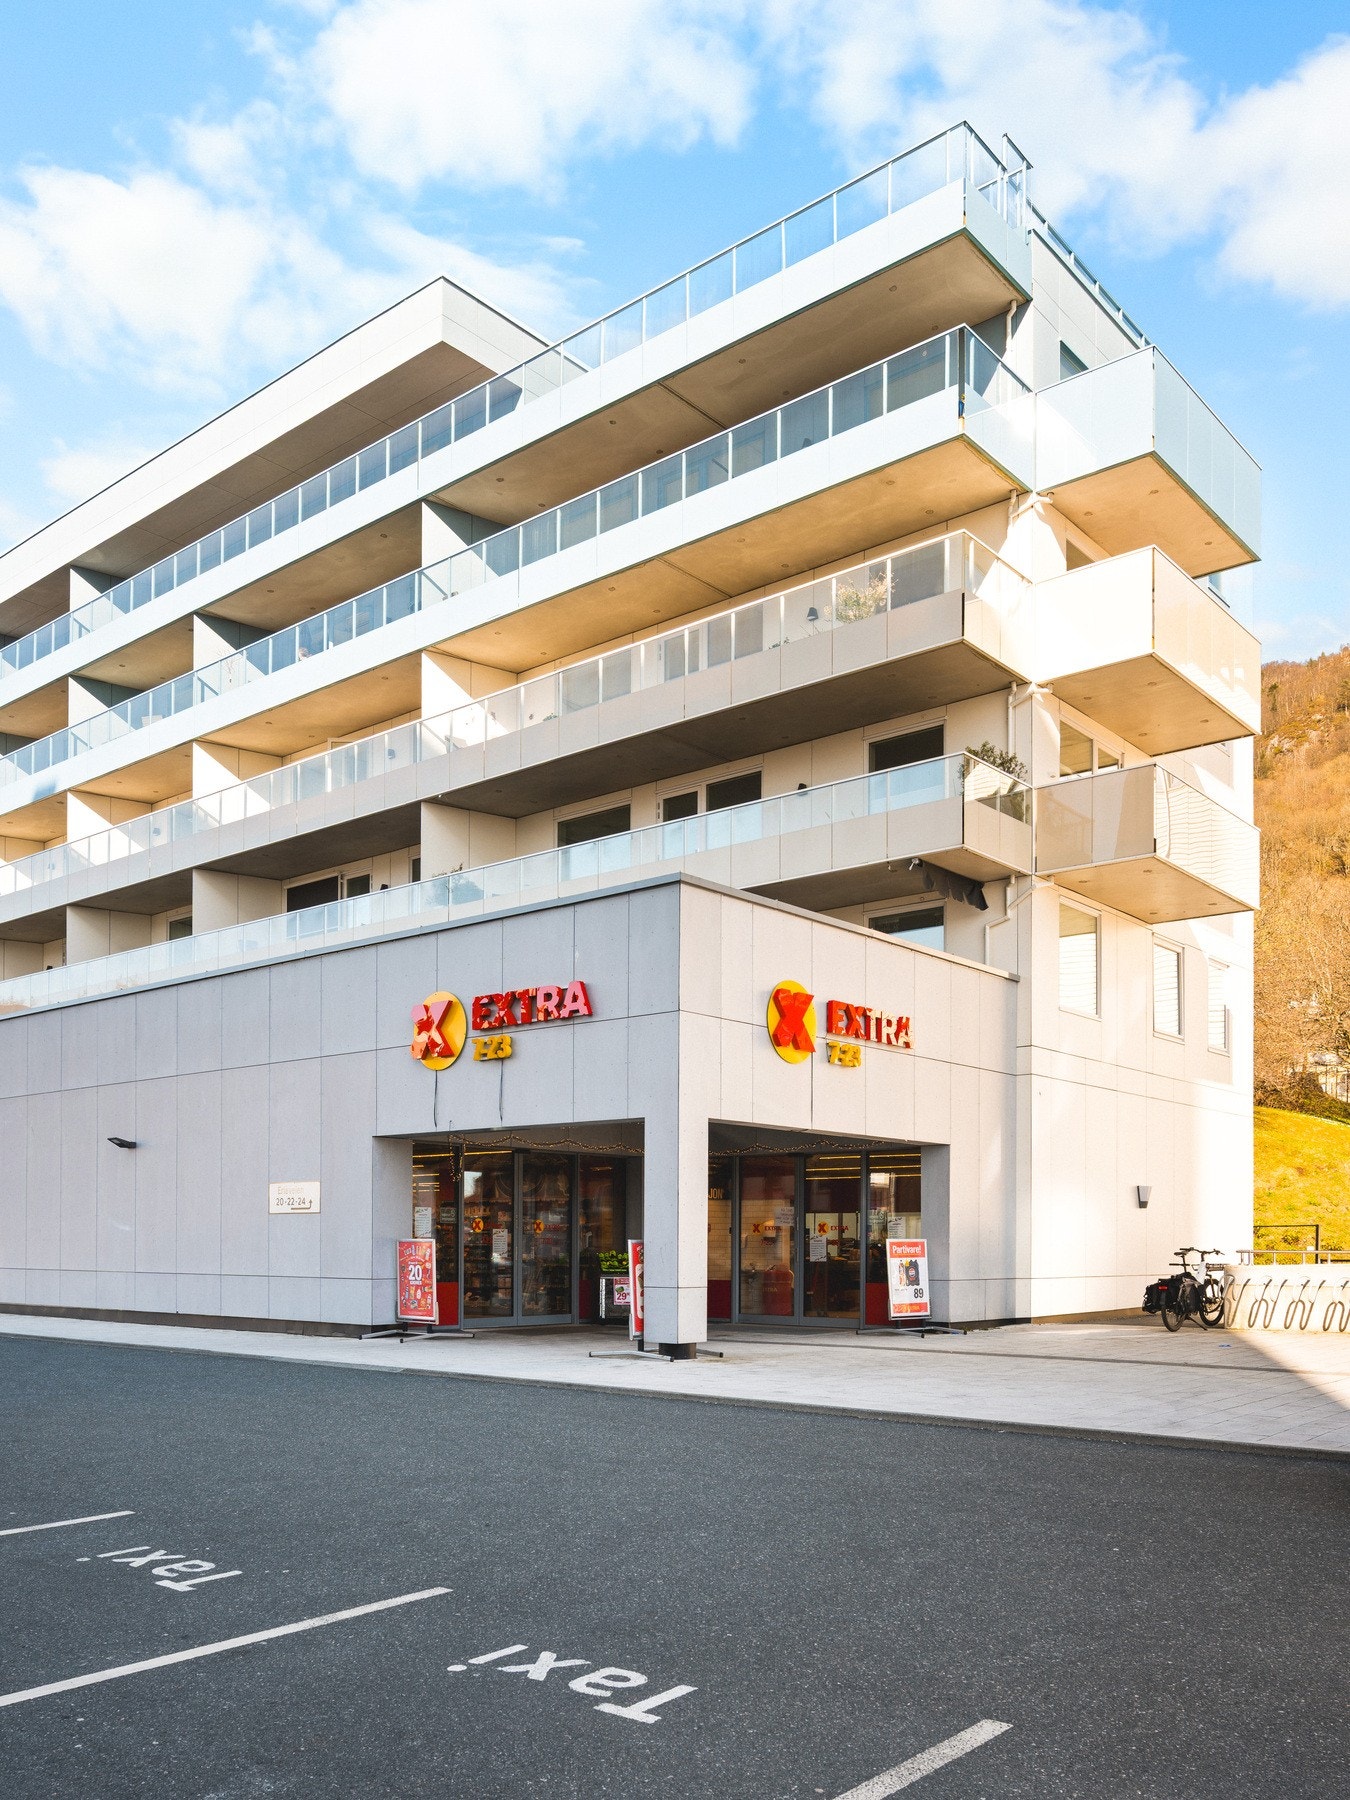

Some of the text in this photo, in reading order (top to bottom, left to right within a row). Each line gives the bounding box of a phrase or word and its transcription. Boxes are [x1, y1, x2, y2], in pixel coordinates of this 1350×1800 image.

[472, 980, 593, 1030] EXTRA
[827, 1000, 914, 1049] EXTRA
[892, 1245, 922, 1254] Partivare!
[408, 1264, 423, 1281] 20
[616, 1292, 627, 1301] 29
[913, 1287, 924, 1299] 89
[75, 1545, 244, 1592] Taxi
[446, 1643, 699, 1724] Taxi
